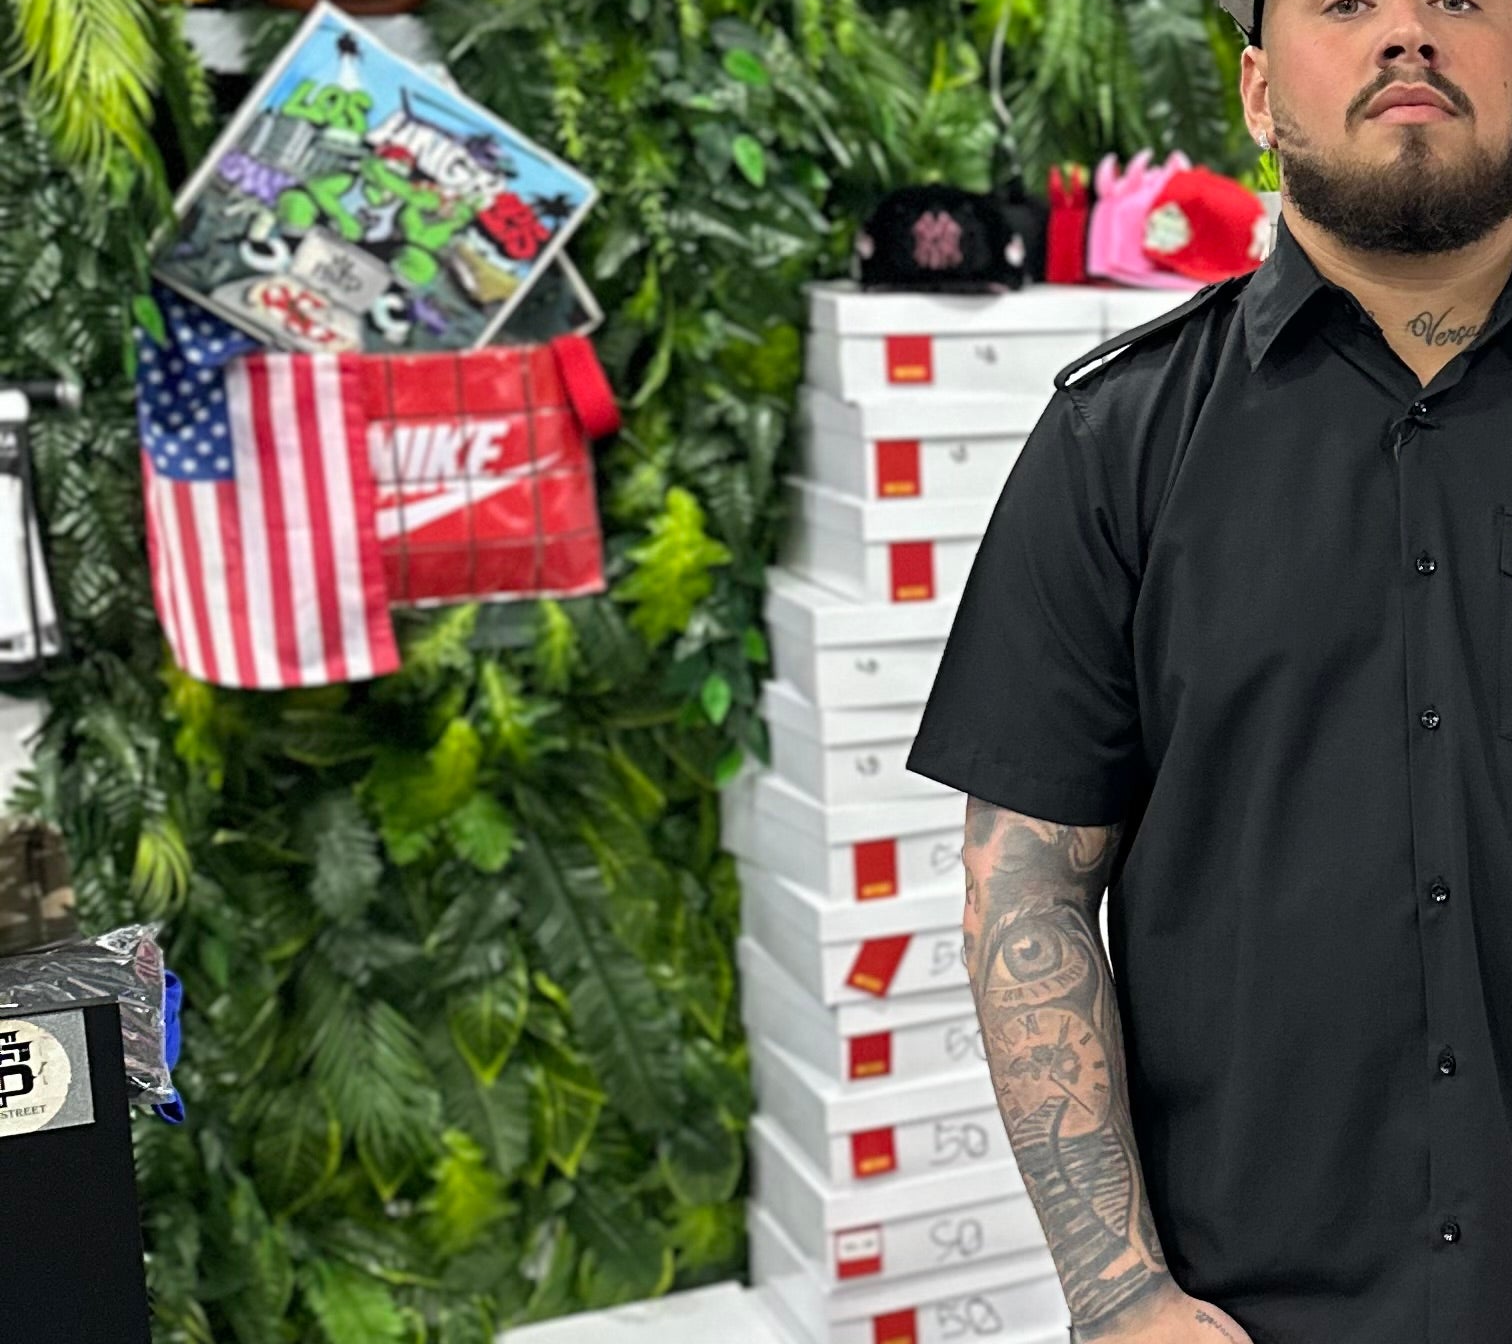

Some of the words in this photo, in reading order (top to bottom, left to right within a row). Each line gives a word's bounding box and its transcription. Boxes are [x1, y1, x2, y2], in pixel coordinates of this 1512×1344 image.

[0, 1104, 47, 1120] STREET
[929, 1122, 990, 1166] 50
[936, 1297, 1003, 1336] 50
